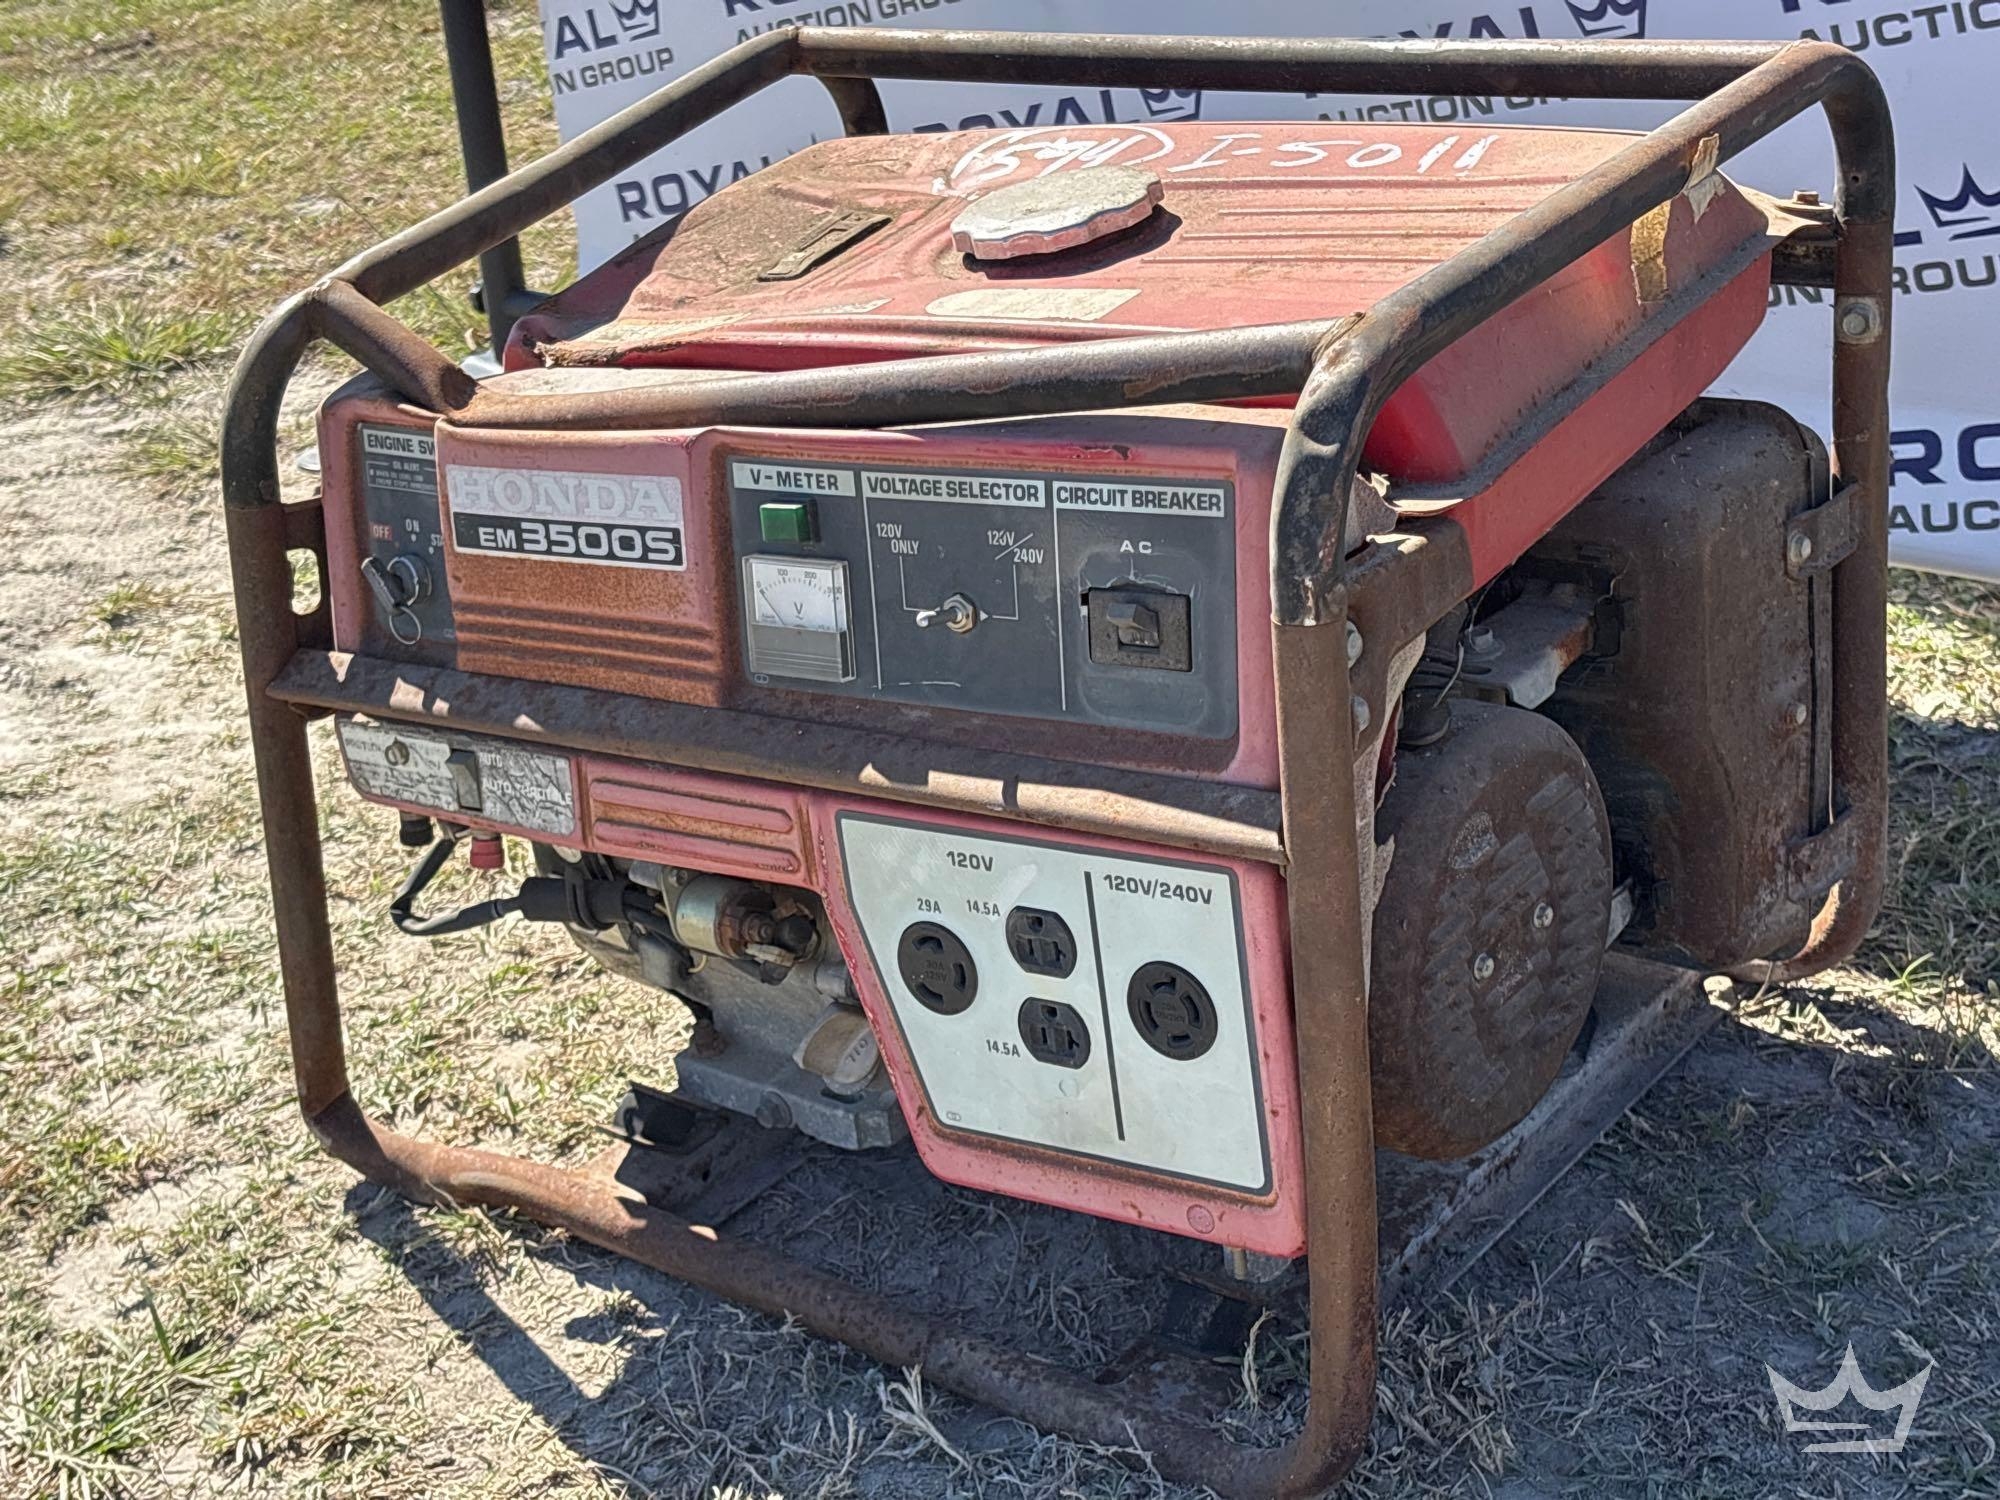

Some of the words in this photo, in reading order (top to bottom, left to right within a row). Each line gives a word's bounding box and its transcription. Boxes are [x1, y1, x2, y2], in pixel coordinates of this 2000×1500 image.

[581, 47, 674, 88] GROUP
[367, 434, 414, 453] ENGINE
[750, 468, 839, 491] V-METER
[867, 475, 943, 497] VOLTAGE
[946, 480, 1039, 502] SELECTOR
[450, 472, 677, 520] HONDA
[1056, 485, 1129, 507] CIRCUIT
[1131, 490, 1221, 512] BREAKER
[373, 525, 390, 538] OFF
[405, 518, 420, 533] ON
[876, 523, 902, 539] 120V
[478, 526, 517, 550] EM
[520, 521, 677, 563] 3500S
[891, 539, 919, 555] ONLY
[1013, 548, 1044, 565] 240V
[777, 568, 789, 577] 100
[804, 570, 817, 579] 200
[793, 601, 804, 615] V
[946, 850, 994, 872] 120V
[1103, 873, 1213, 906] 120V/240V
[917, 897, 942, 915] 29A
[966, 899, 1001, 918] 14.5A
[986, 1039, 1020, 1059] 14.5A
